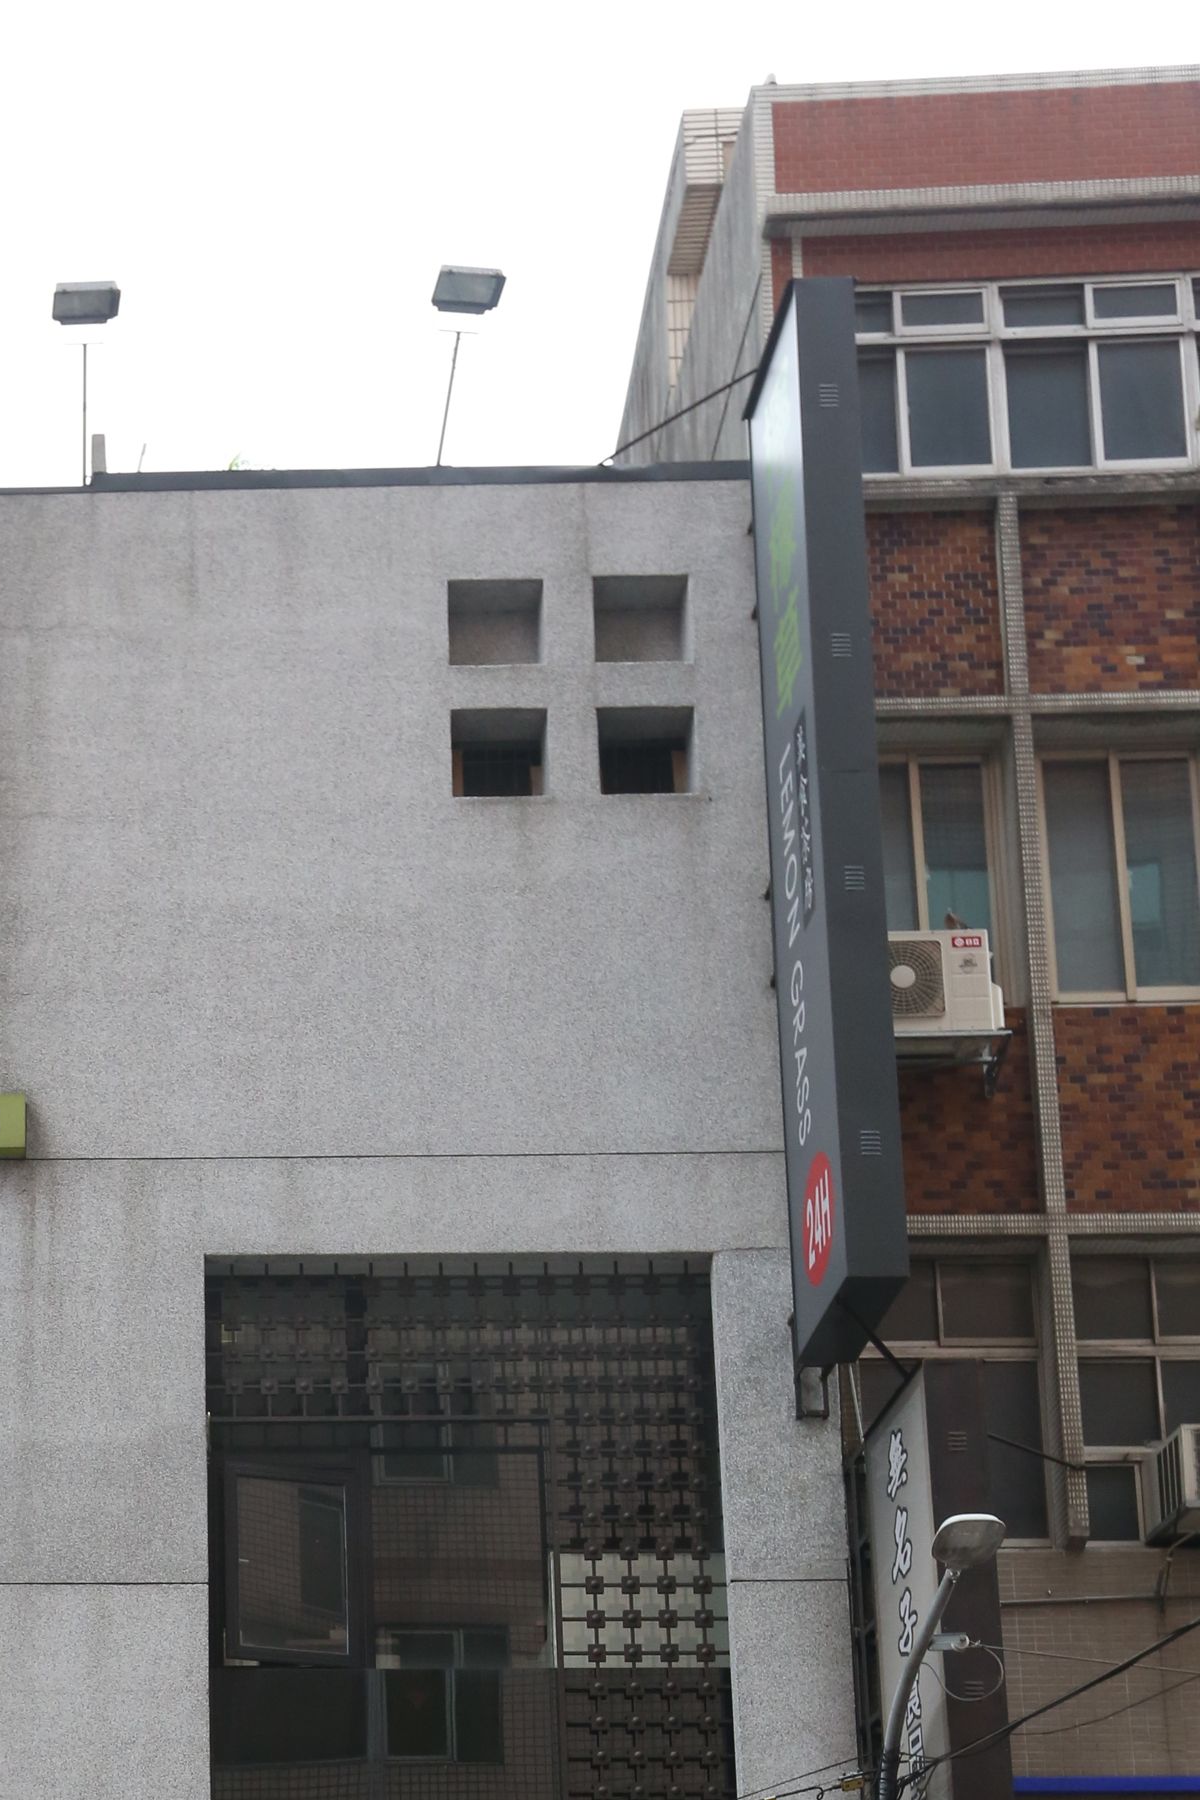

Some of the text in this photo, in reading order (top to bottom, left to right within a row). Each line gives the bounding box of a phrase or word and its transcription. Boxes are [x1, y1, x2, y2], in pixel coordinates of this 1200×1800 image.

[779, 743, 812, 1147] LEMON GRASS
[807, 1169, 832, 1271] 24H
